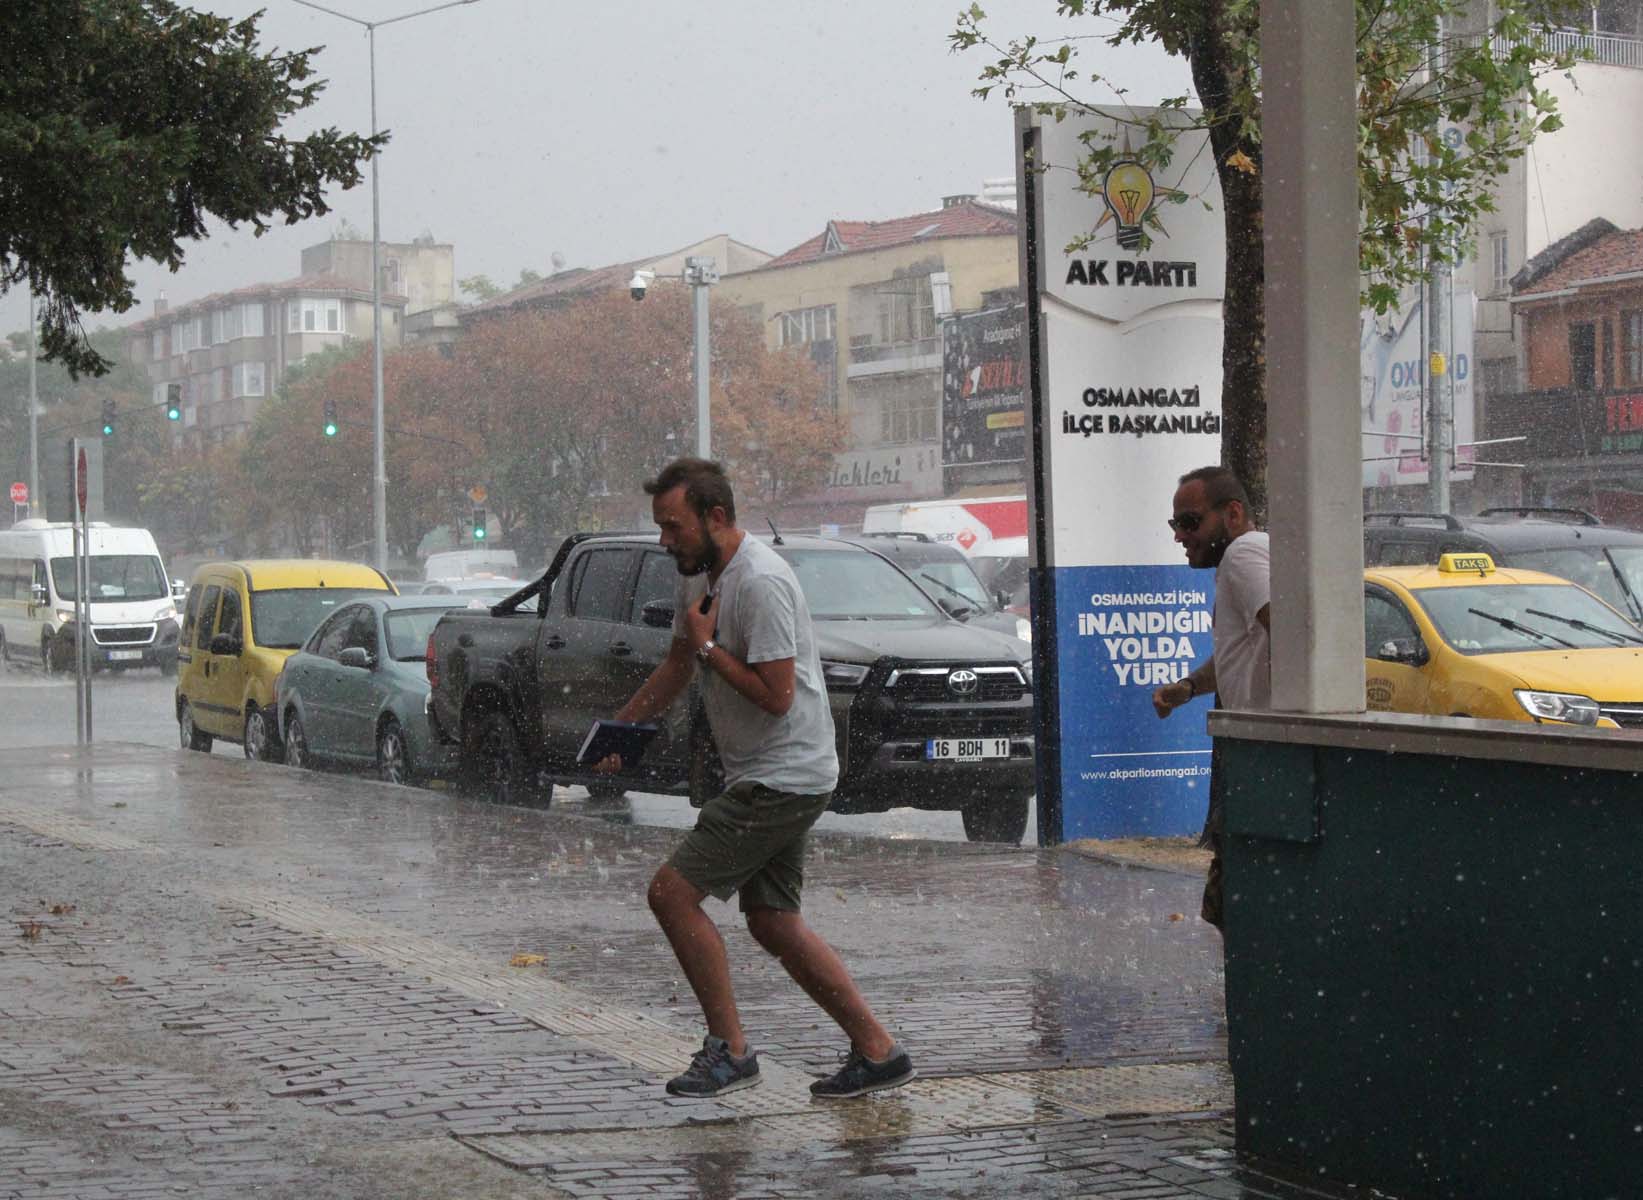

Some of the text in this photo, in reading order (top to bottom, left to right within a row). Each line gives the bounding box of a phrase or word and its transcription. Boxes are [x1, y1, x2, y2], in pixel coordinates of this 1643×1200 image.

[1066, 259, 1109, 286] AK
[1082, 385, 1200, 407] OSMANGAZİ
[1063, 410, 1220, 438] İLÇE BAŞKANLIĞI
[1091, 589, 1206, 607] OSMANGAZİ İÇİN
[1078, 608, 1212, 635] İNANDIĞIN
[1103, 636, 1196, 660] YOLDA
[1112, 661, 1189, 686] YÜRÜ
[935, 740, 1006, 757] 16 BDH 11
